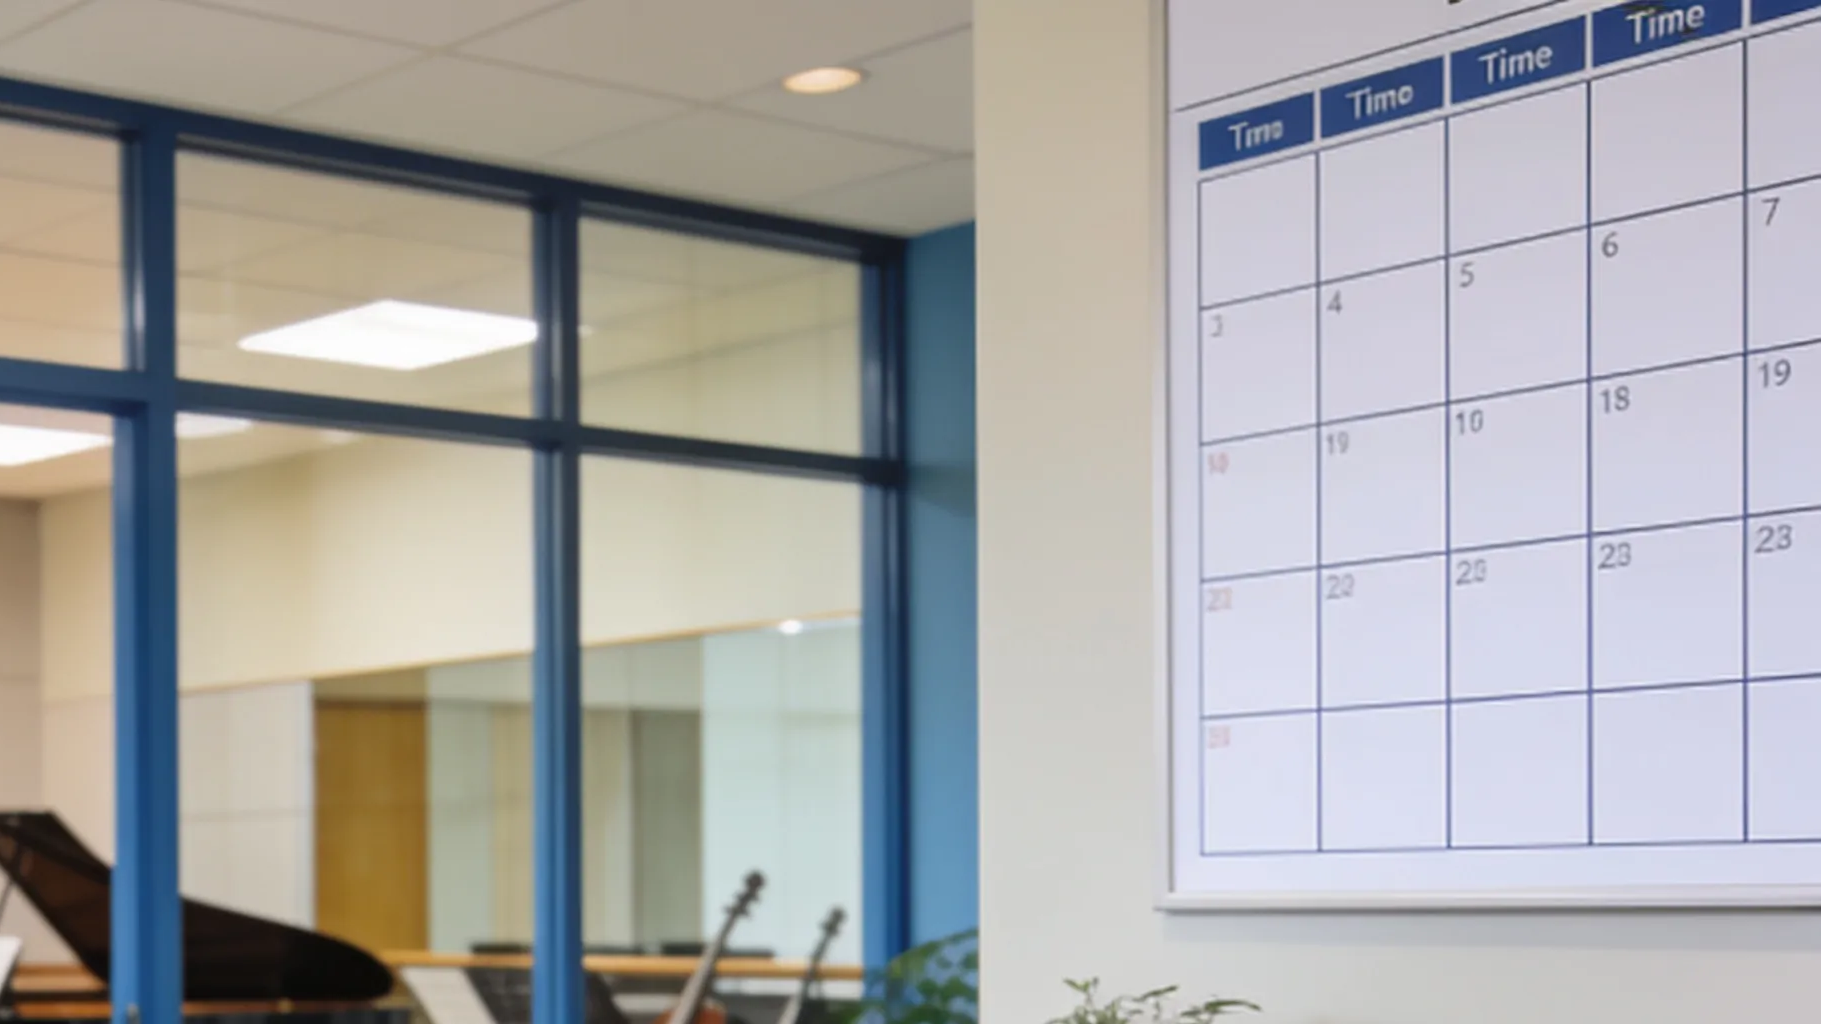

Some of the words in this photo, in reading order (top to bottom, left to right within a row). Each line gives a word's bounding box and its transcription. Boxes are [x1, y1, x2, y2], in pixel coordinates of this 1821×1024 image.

[1478, 46, 1553, 84] Time
[1625, 4, 1705, 44] Time
[1761, 197, 1780, 226] 7
[1601, 231, 1619, 258] 6
[1459, 261, 1475, 288] 5
[1326, 289, 1343, 315] 4
[1758, 359, 1791, 388] 19
[1600, 385, 1631, 413] 18
[1455, 409, 1484, 435] 10
[1754, 524, 1793, 553] 23
